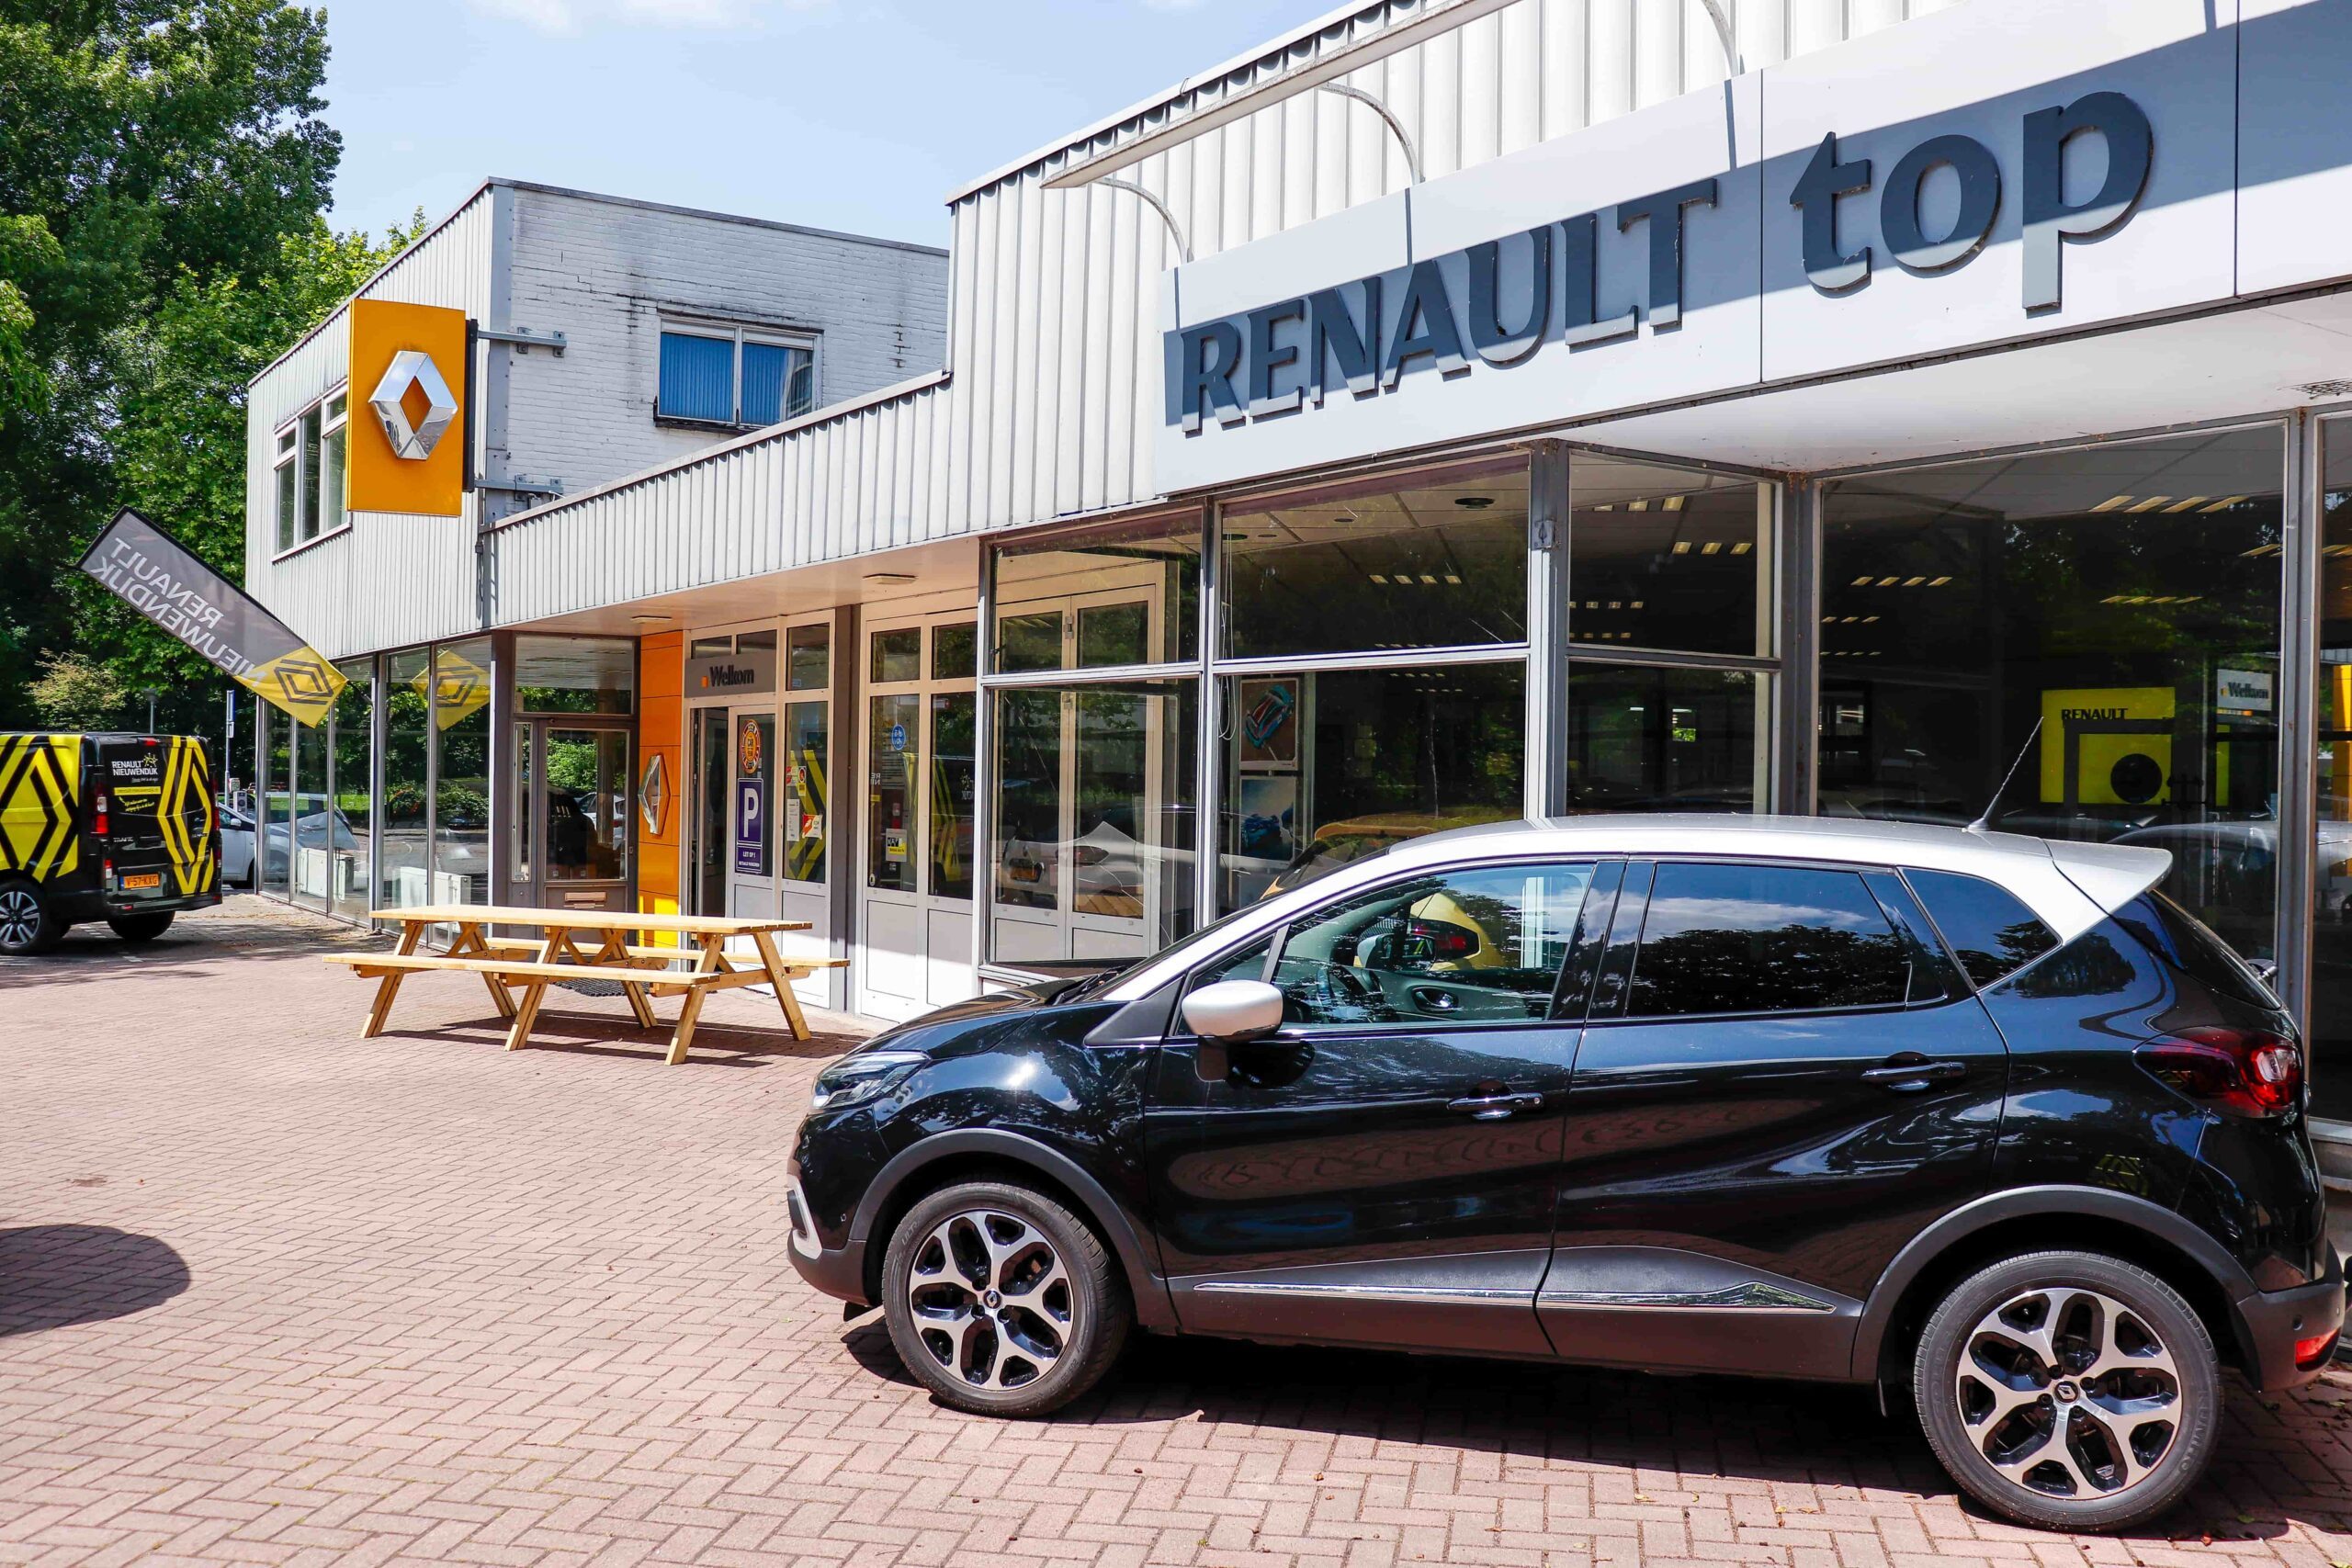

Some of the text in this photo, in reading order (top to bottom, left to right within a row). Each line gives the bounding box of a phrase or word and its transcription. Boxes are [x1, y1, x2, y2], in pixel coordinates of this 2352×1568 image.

[1181, 90, 2154, 437] RENAULT top
[709, 664, 754, 687] Welkom
[2061, 707, 2130, 720] RENAULT
[111, 761, 142, 769] RENAULT
[112, 767, 159, 776] NIEUWENDIJK
[743, 787, 759, 838] P
